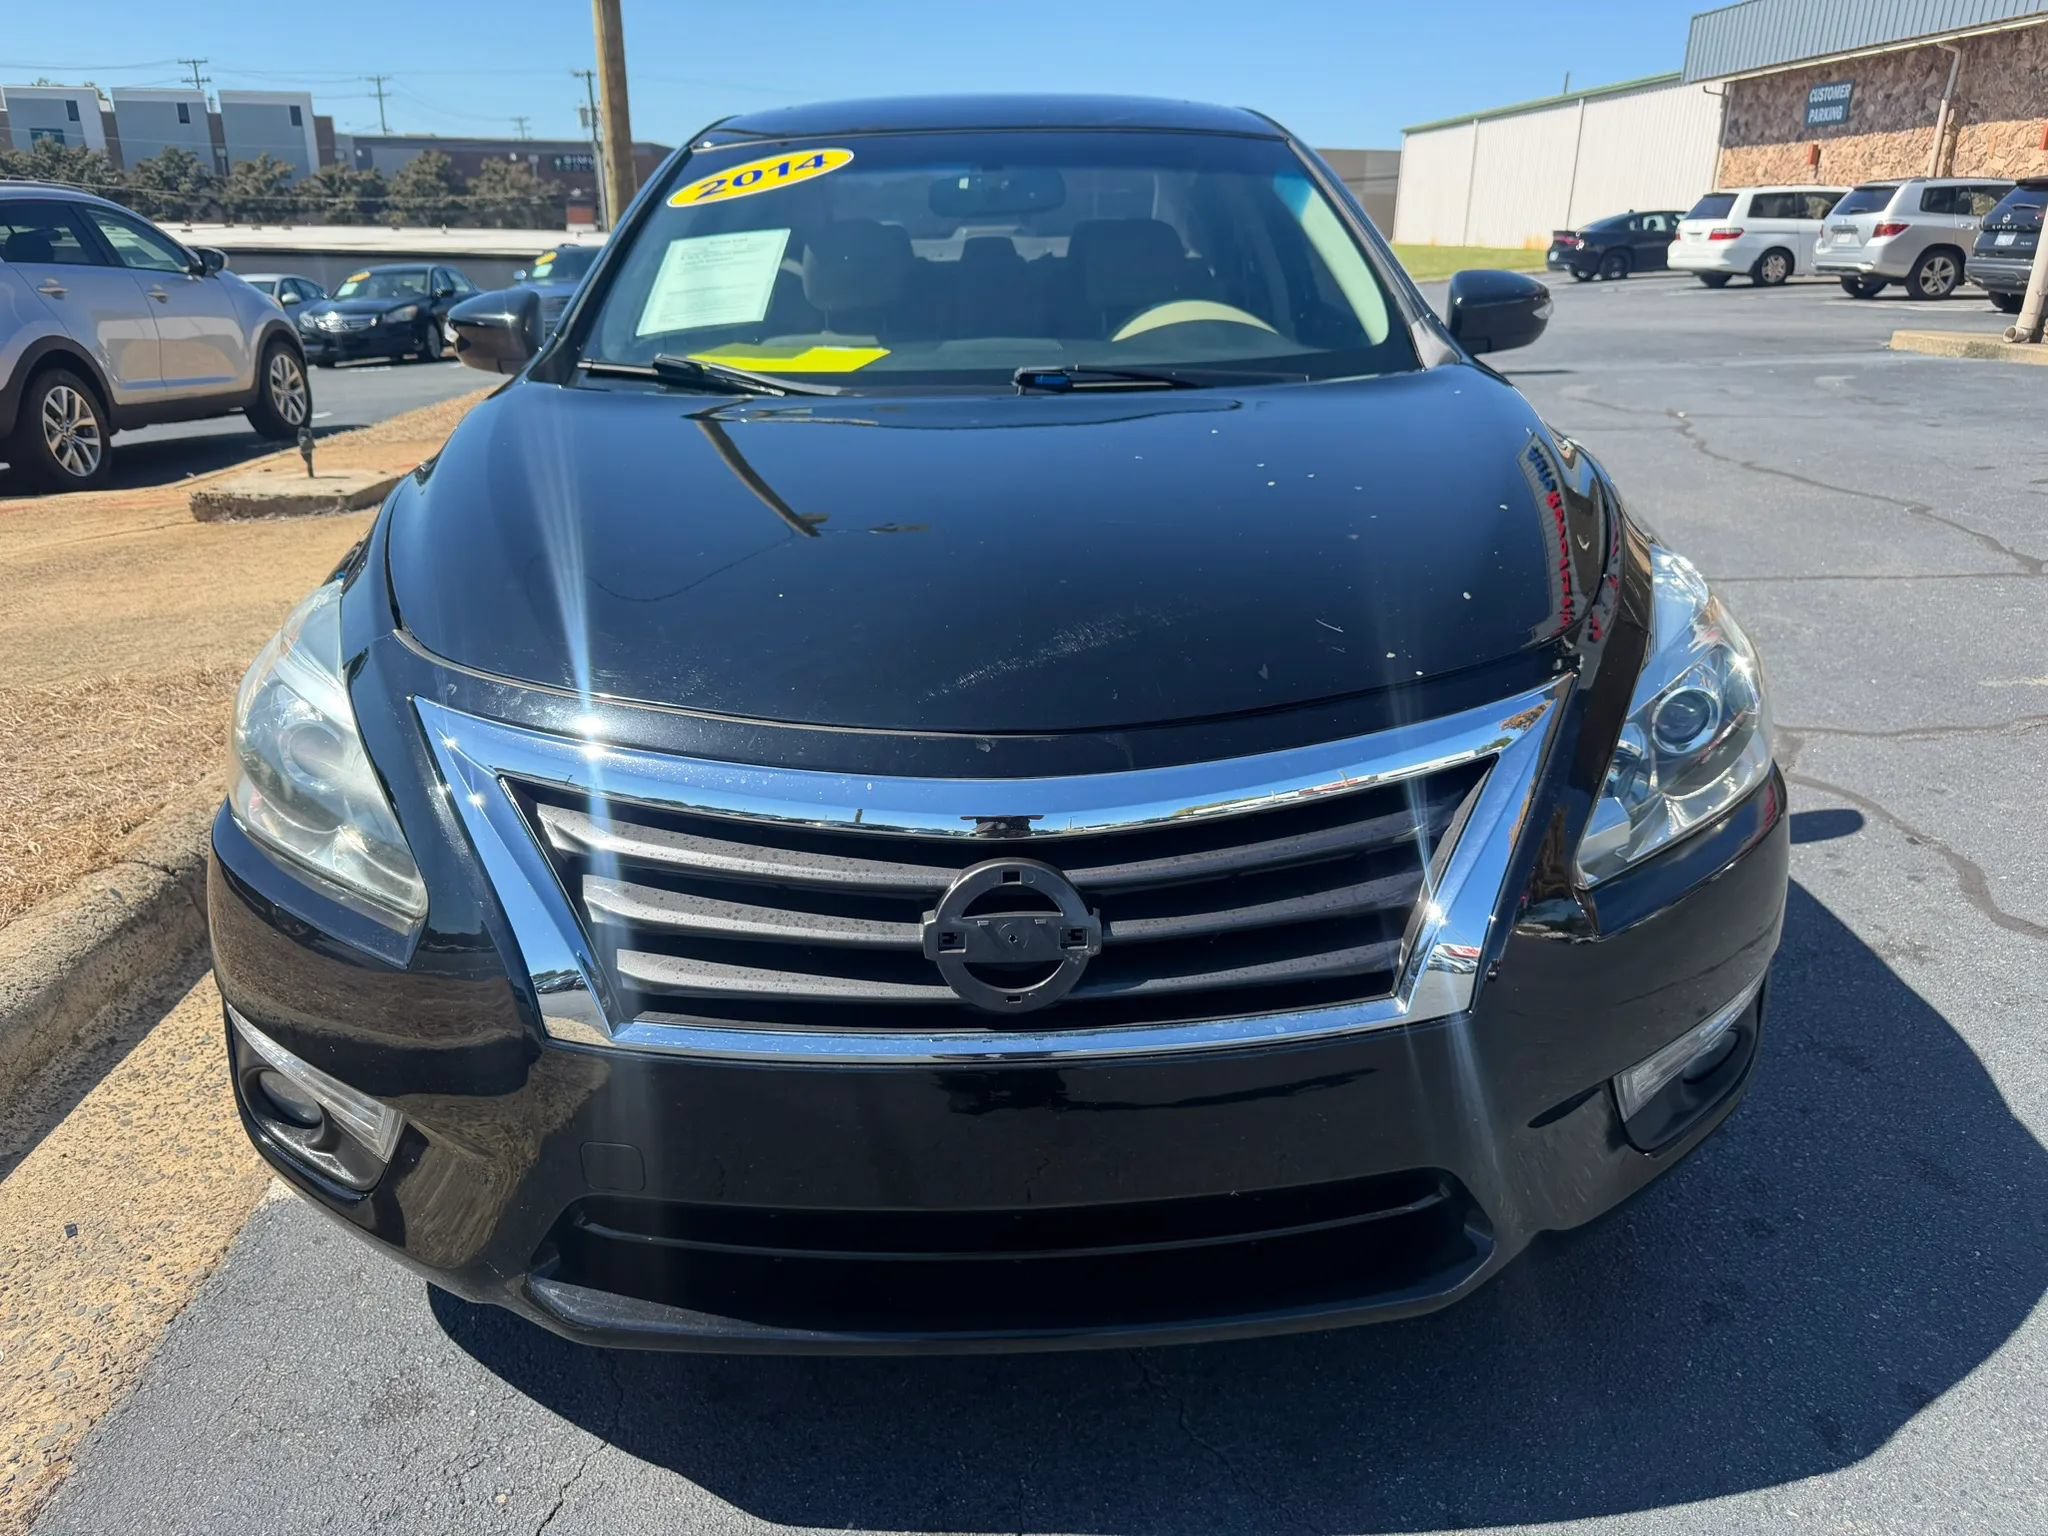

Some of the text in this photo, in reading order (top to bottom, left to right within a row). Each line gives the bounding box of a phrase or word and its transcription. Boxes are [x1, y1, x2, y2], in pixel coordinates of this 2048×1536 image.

[1809, 84, 1851, 103] CUSTOMER
[1808, 105, 1843, 123] PARKING
[695, 154, 828, 201] 2014
